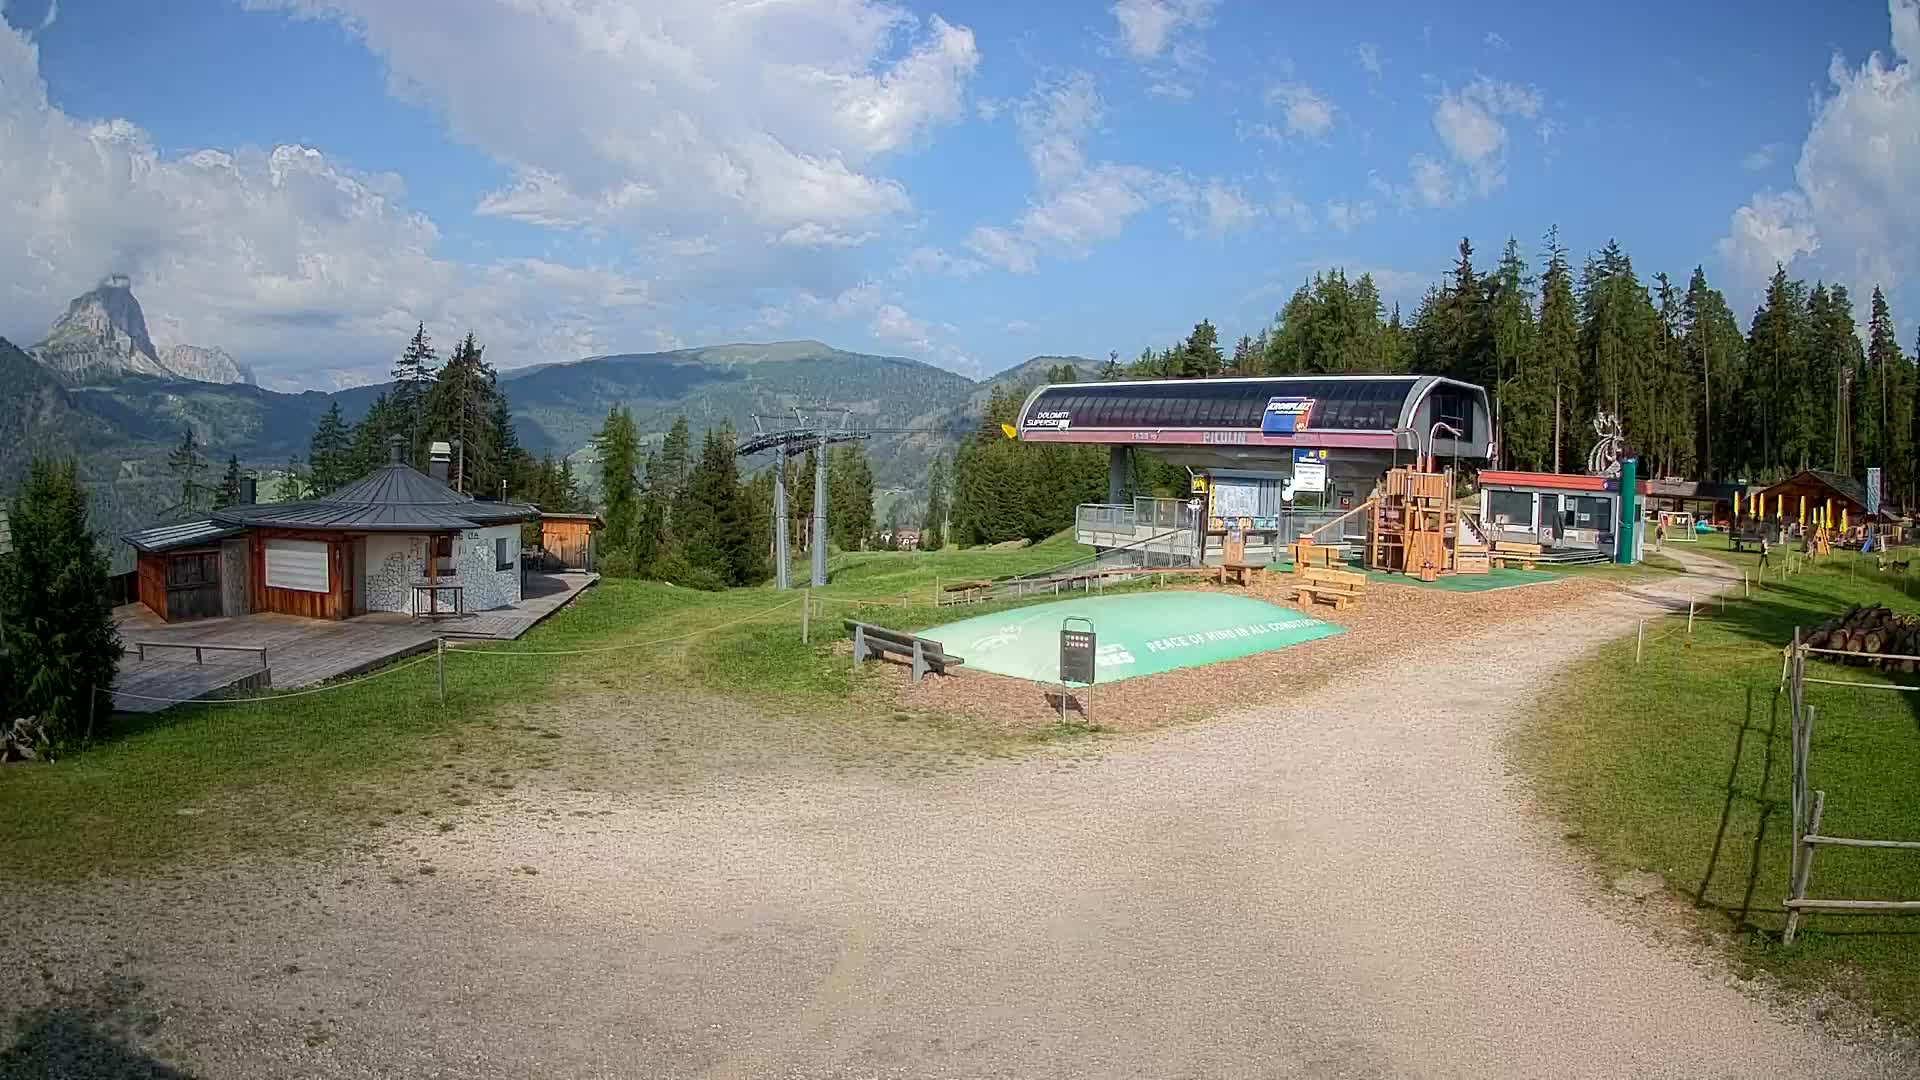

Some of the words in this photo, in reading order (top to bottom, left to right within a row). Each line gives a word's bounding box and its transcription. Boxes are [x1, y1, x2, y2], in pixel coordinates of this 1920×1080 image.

[1145, 635, 1190, 653] PEACE
[1188, 632, 1205, 645] OF
[1205, 629, 1236, 641] MIND
[1249, 623, 1270, 634] ALL
